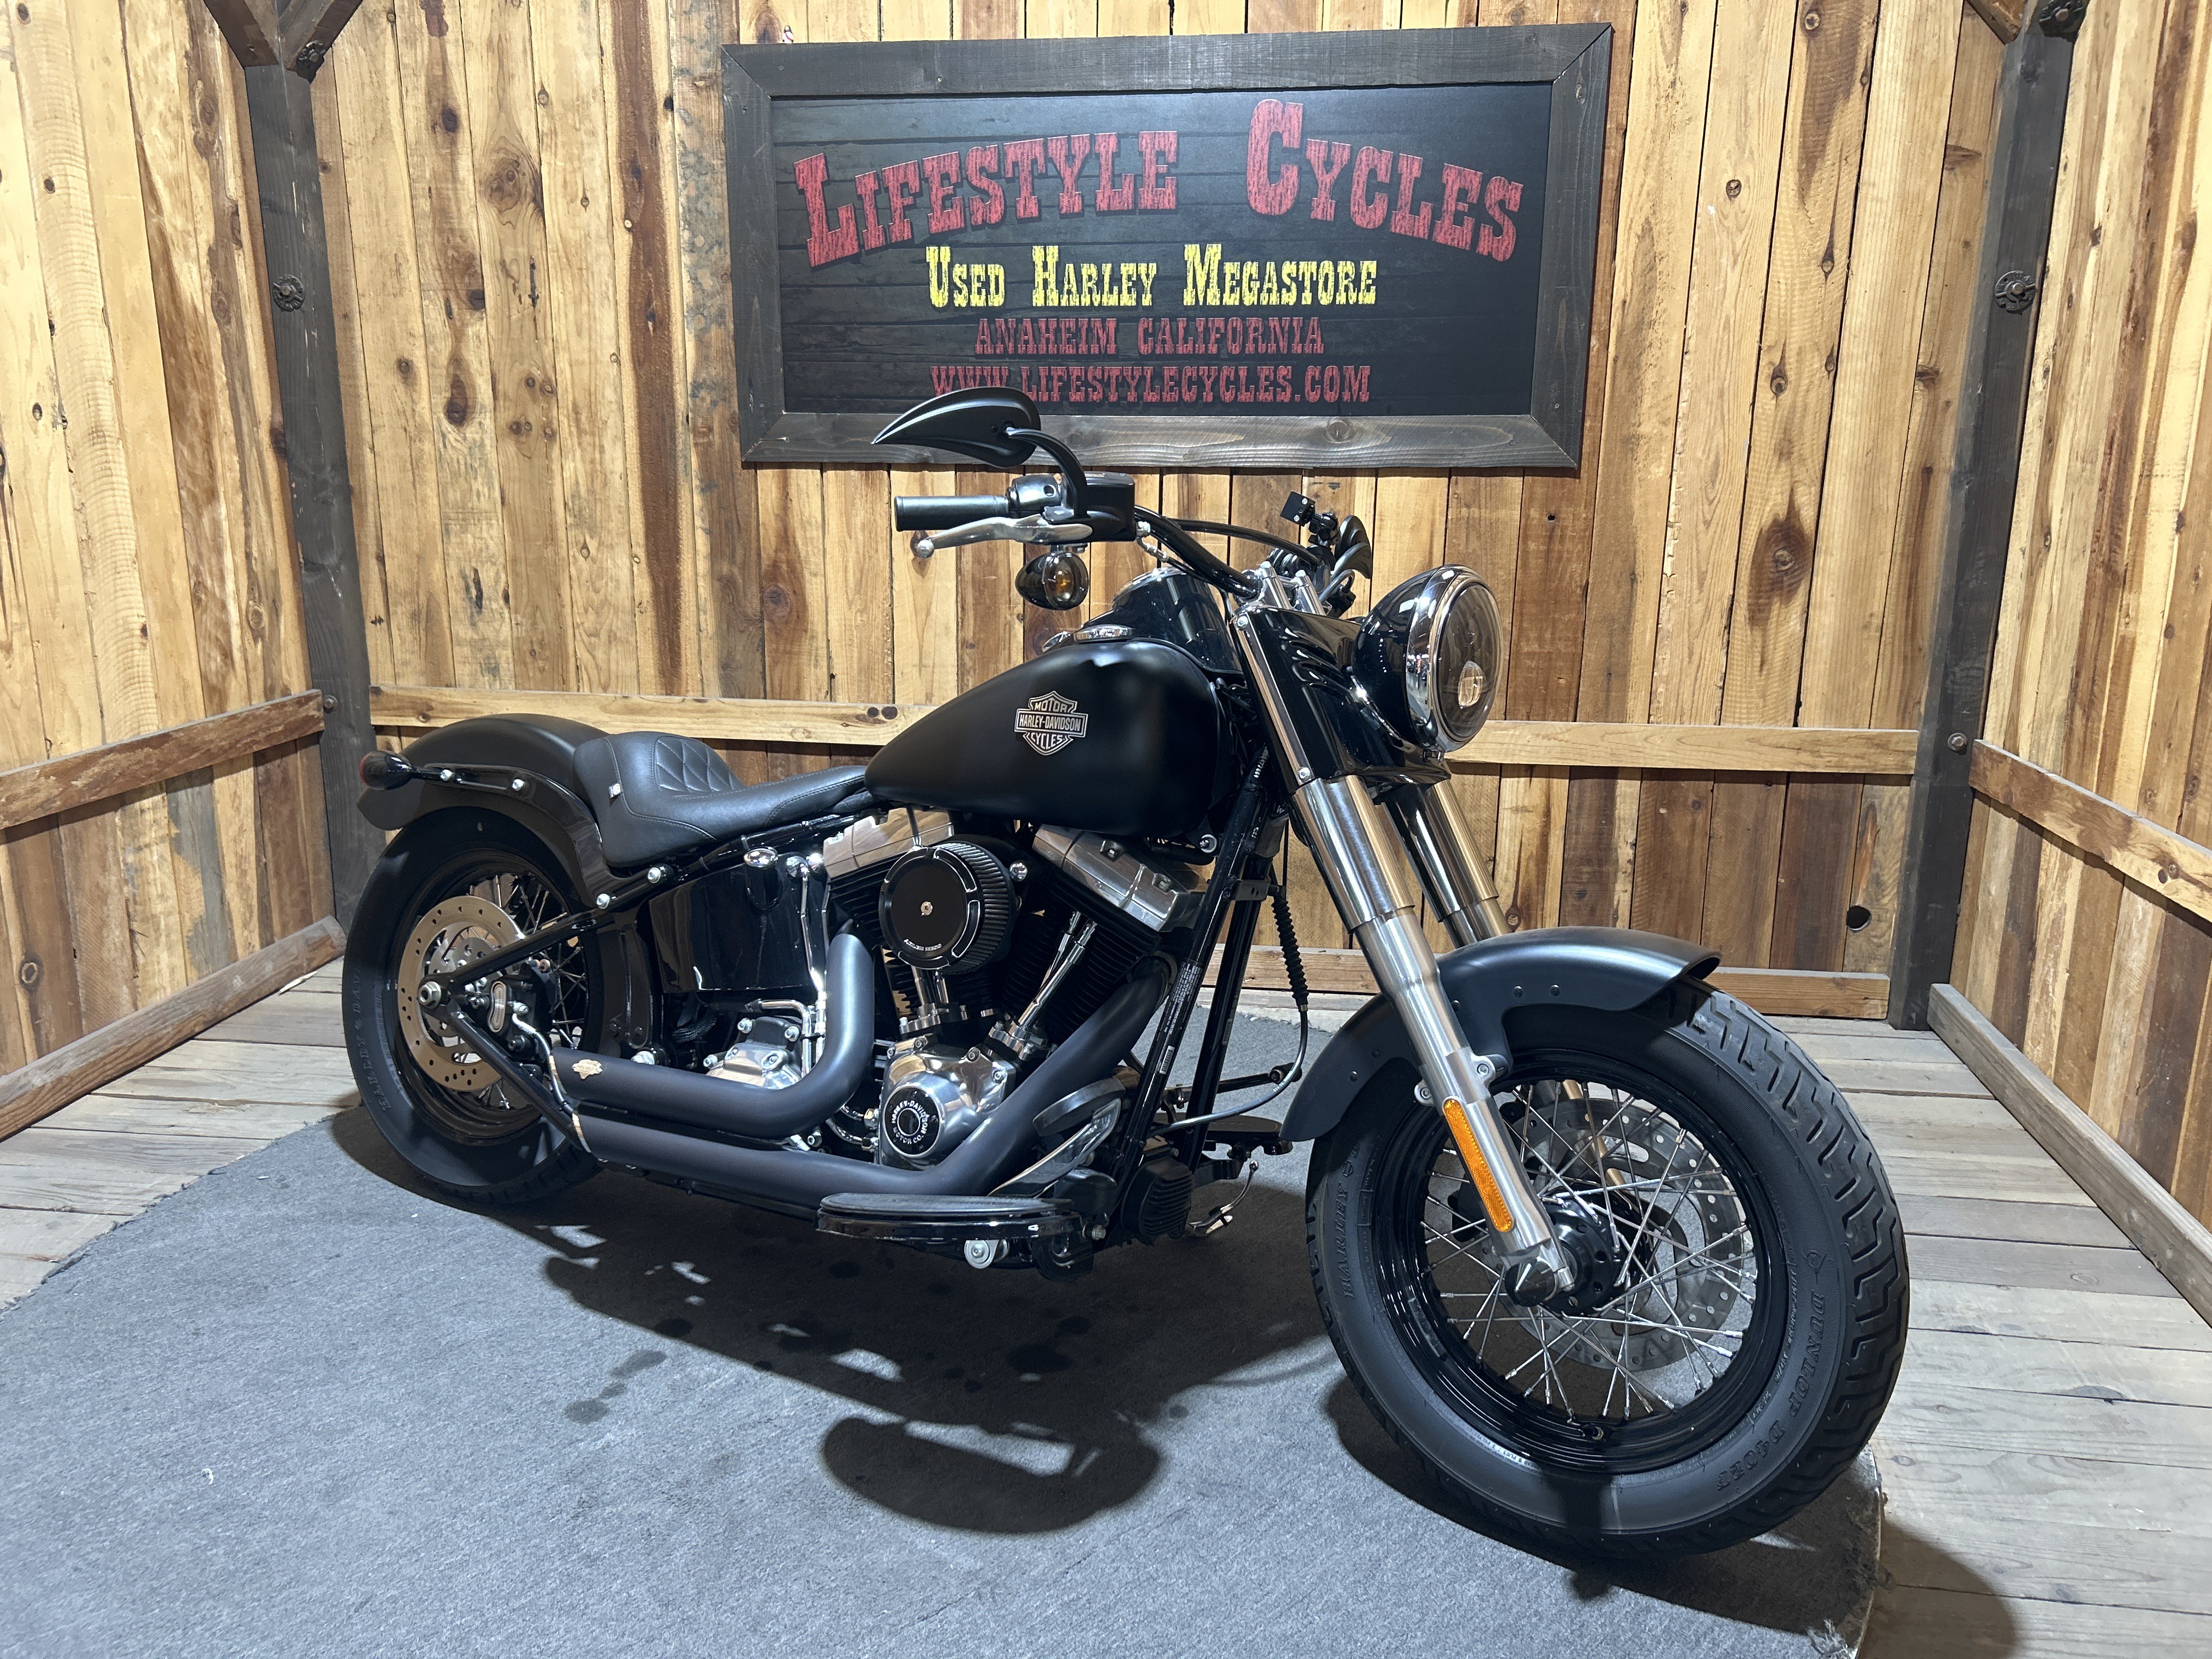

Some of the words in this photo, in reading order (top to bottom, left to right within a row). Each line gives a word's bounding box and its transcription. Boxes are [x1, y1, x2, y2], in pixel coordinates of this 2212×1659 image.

[793, 131, 1178, 268] LIFESTYLE
[1245, 99, 1524, 262] CYCLES
[925, 246, 1005, 307] USED
[1031, 245, 1158, 307] HARLEY
[1183, 244, 1378, 306] MEGASTORE
[974, 318, 1118, 356] ANAHEIM
[1137, 317, 1325, 355] CALIFORNIA
[930, 365, 1370, 403] WWWLIFESTYLECYCLES.COM
[1019, 714, 1081, 731] HARLEY-DAVIDSON
[1035, 697, 1068, 713] MOTOR
[1030, 731, 1063, 750] CYCLES
[356, 1035, 392, 1111] HARLEY
[893, 1127, 912, 1144] MOTOR
[1335, 1181, 1356, 1300] HARLEY
[1788, 1289, 1825, 1417] DUNLOP
